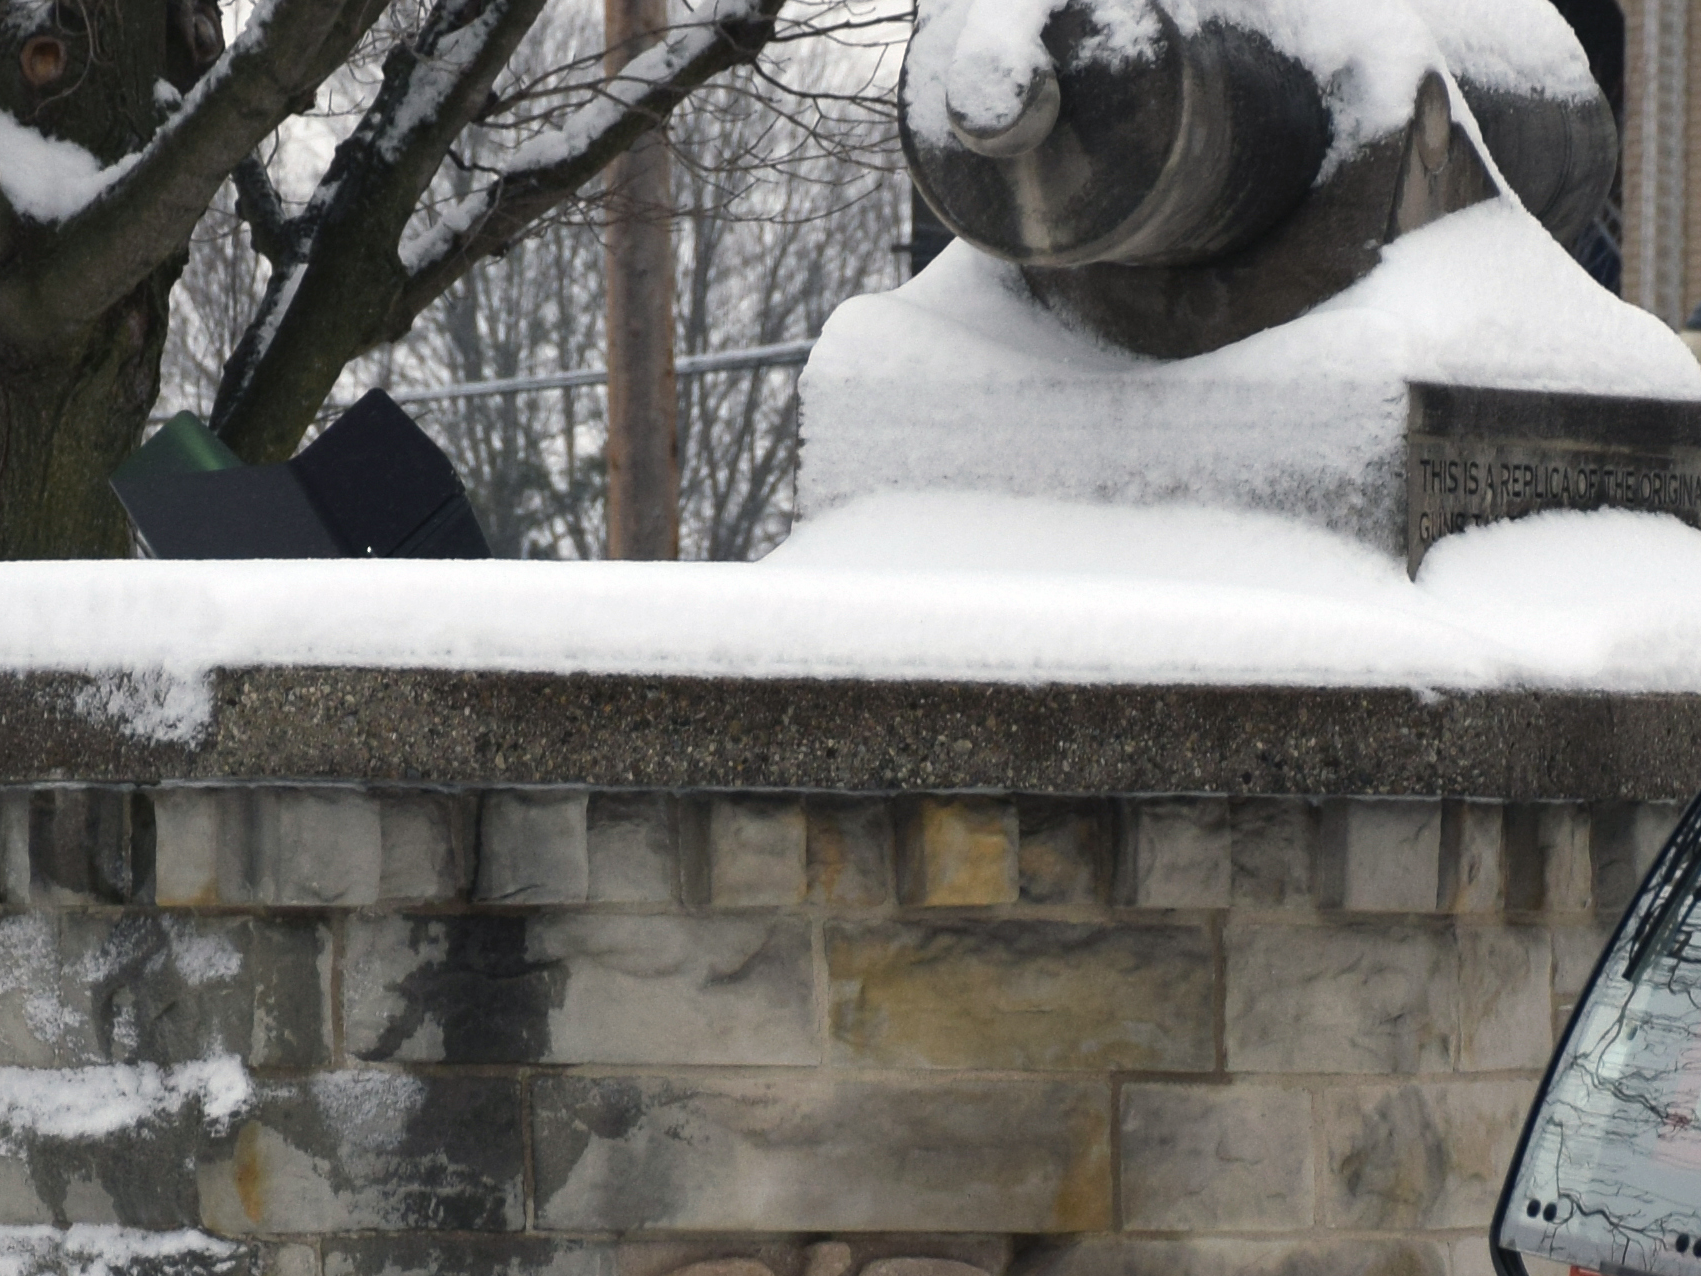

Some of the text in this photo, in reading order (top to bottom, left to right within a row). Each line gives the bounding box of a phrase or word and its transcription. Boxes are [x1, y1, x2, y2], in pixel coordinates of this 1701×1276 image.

[1419, 458, 1458, 494] THIS
[1463, 461, 1479, 495] IS
[1485, 462, 1496, 493] A
[1500, 463, 1572, 500] REPLICA
[1577, 468, 1599, 500] OF
[1603, 470, 1635, 503] THE
[1419, 512, 1465, 542] GUNS
